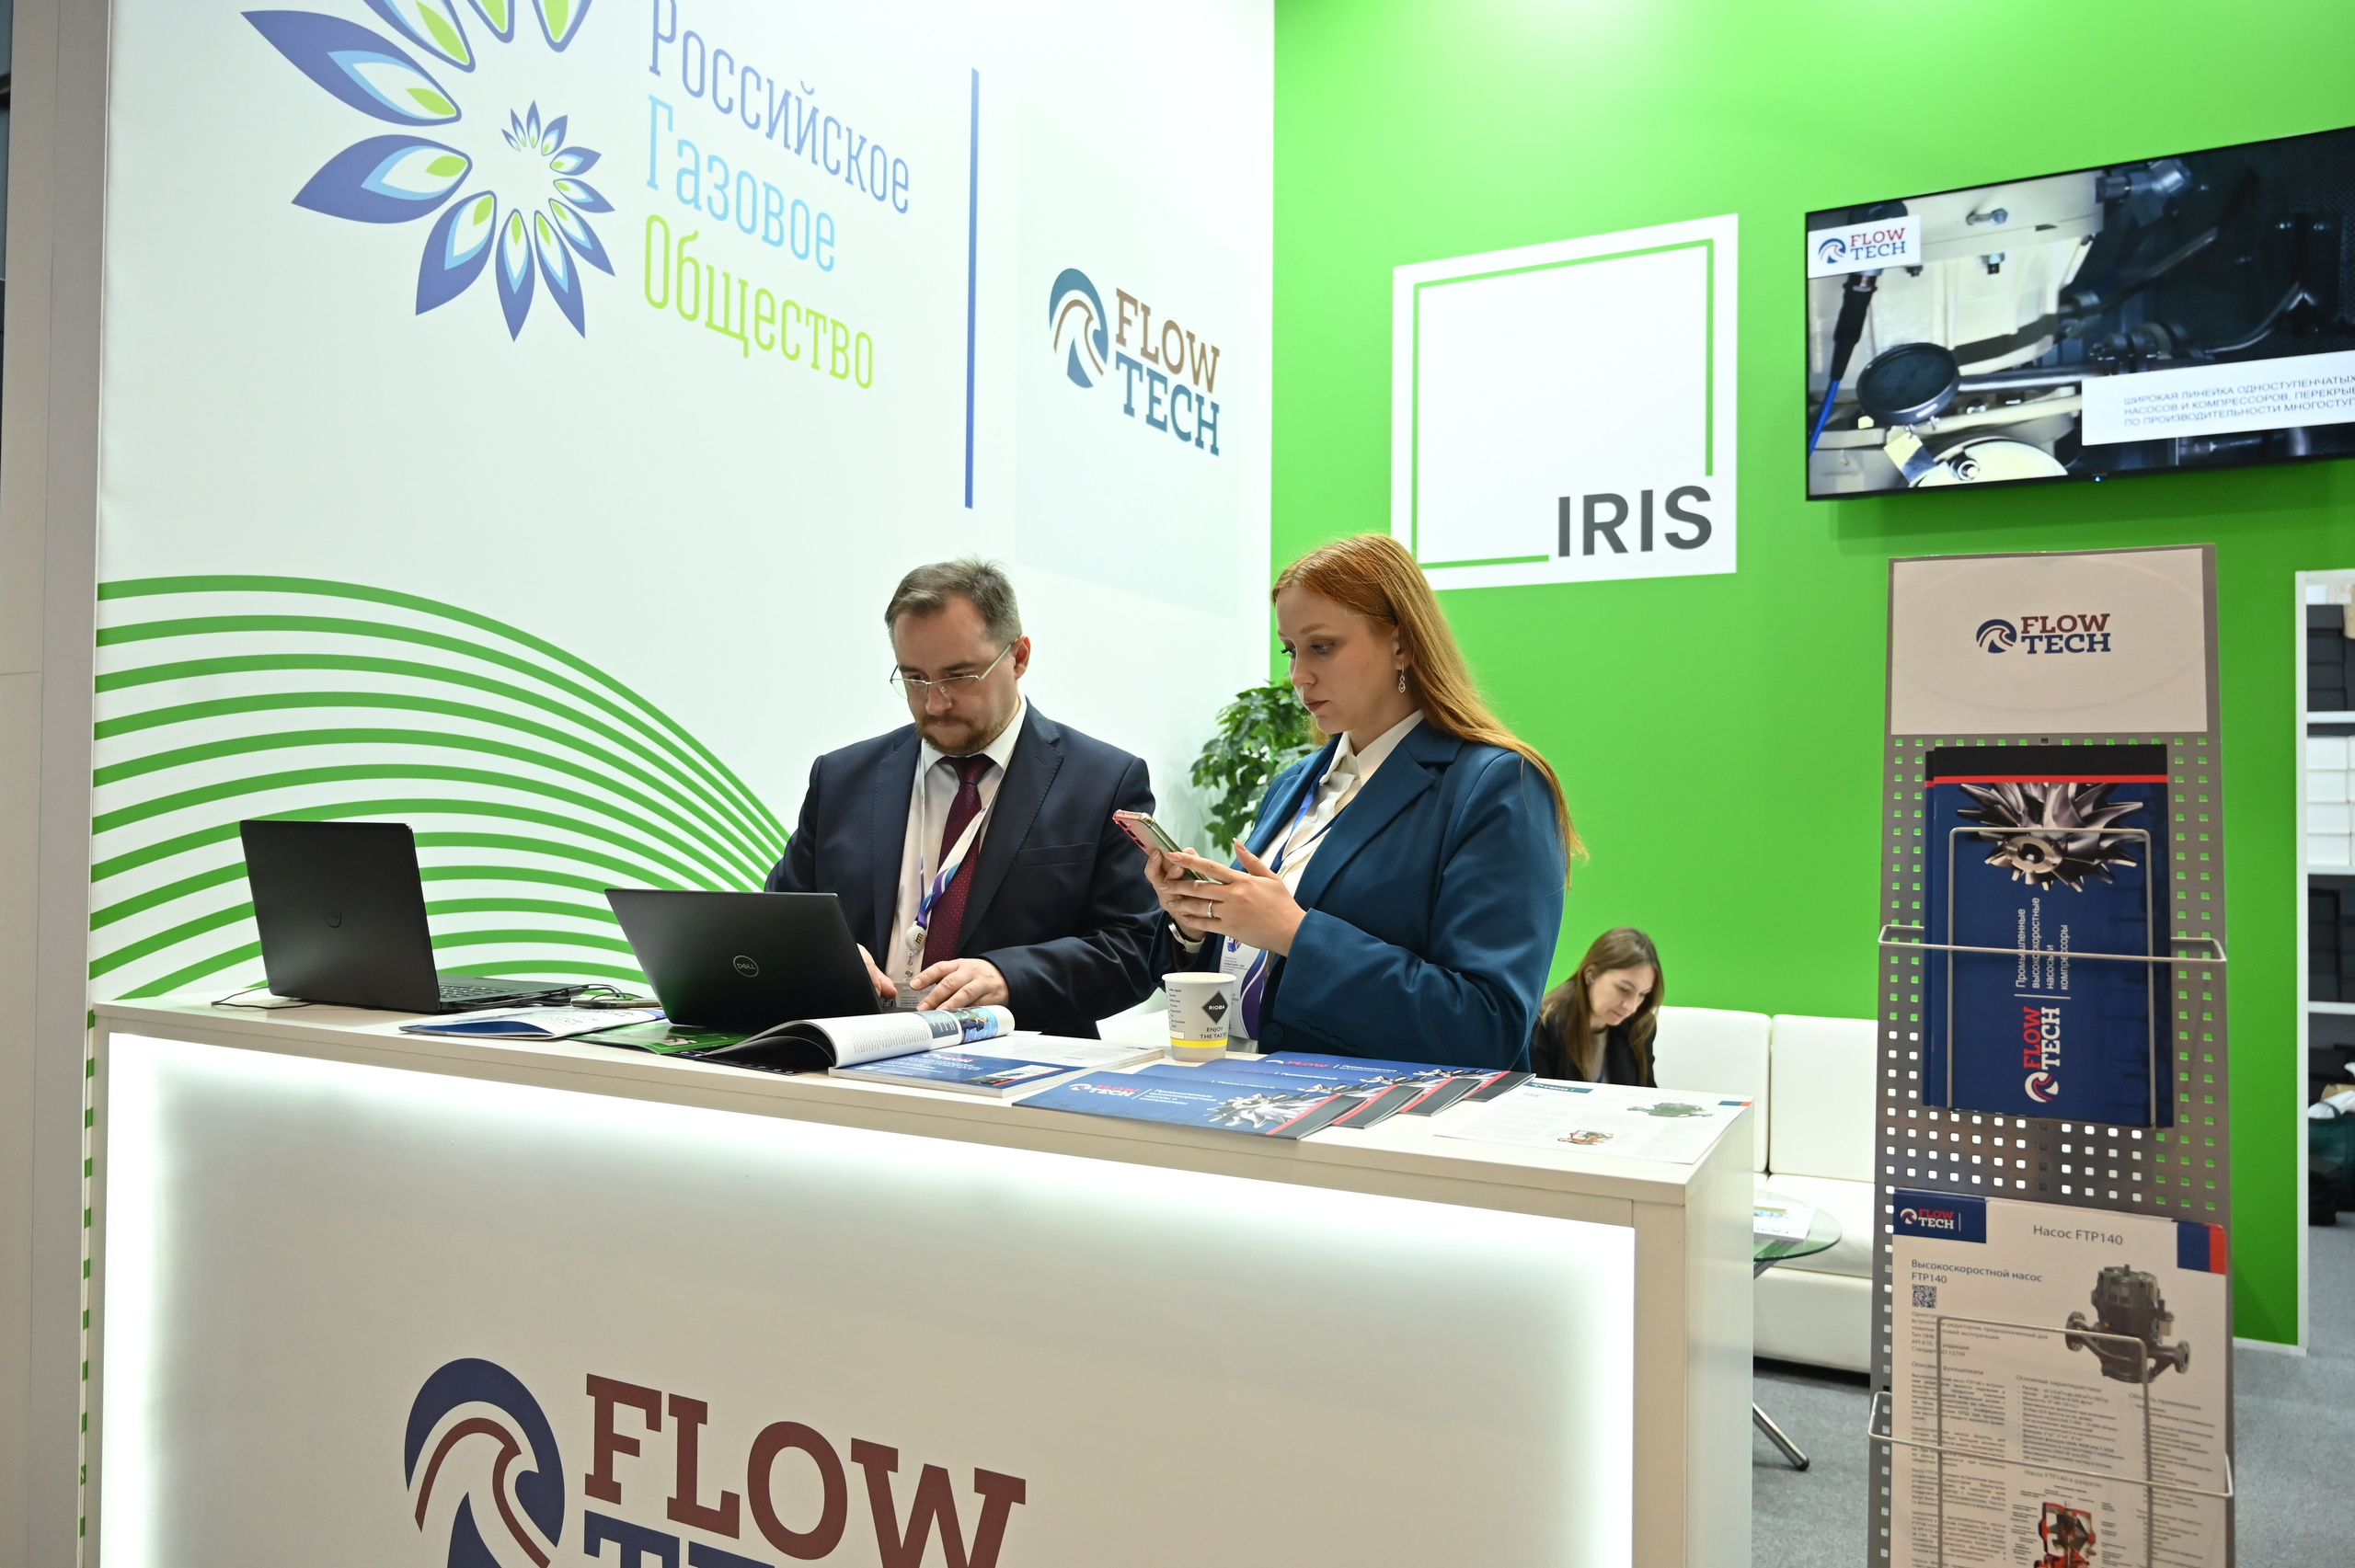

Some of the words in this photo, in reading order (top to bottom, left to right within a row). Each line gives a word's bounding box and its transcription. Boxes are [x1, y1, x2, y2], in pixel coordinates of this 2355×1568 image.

[649, 0, 909, 214] Российское
[646, 94, 835, 272] Газовое
[1851, 227, 1906, 247] FLOW
[1851, 241, 1906, 260] TECH
[644, 214, 873, 389] Общество
[1116, 287, 1220, 394] FLOW
[1116, 350, 1220, 457] TECH
[2124, 393, 2178, 406] ШИРОКАЯ
[2182, 385, 2234, 398] ЛИНЕЙКА
[2124, 403, 2177, 416] НАСОСОВ
[2181, 402, 2188, 410] И
[2124, 418, 2141, 427] ПО
[2143, 405, 2280, 425] ПРОИЗВОДИТЕЛЬНОСТИ
[1558, 485, 1712, 557] IRIS
[2021, 613, 2110, 635] FLOW
[2021, 633, 2111, 654] TECH
[2024, 1006, 2041, 1070] FLOW
[2041, 1007, 2061, 1070] TECH
[1089, 1087, 1136, 1097] TECH
[1918, 1208, 1955, 1219] FLOW
[1918, 1218, 1955, 1230] TECH
[2033, 1224, 2072, 1239] Насос
[2075, 1230, 2123, 1245] FTP140
[1912, 1259, 2010, 1278] Высокоскоростной
[2012, 1273, 2042, 1282] насос
[1912, 1272, 1947, 1284] FTP140
[585, 1373, 1026, 1568] FLOW
